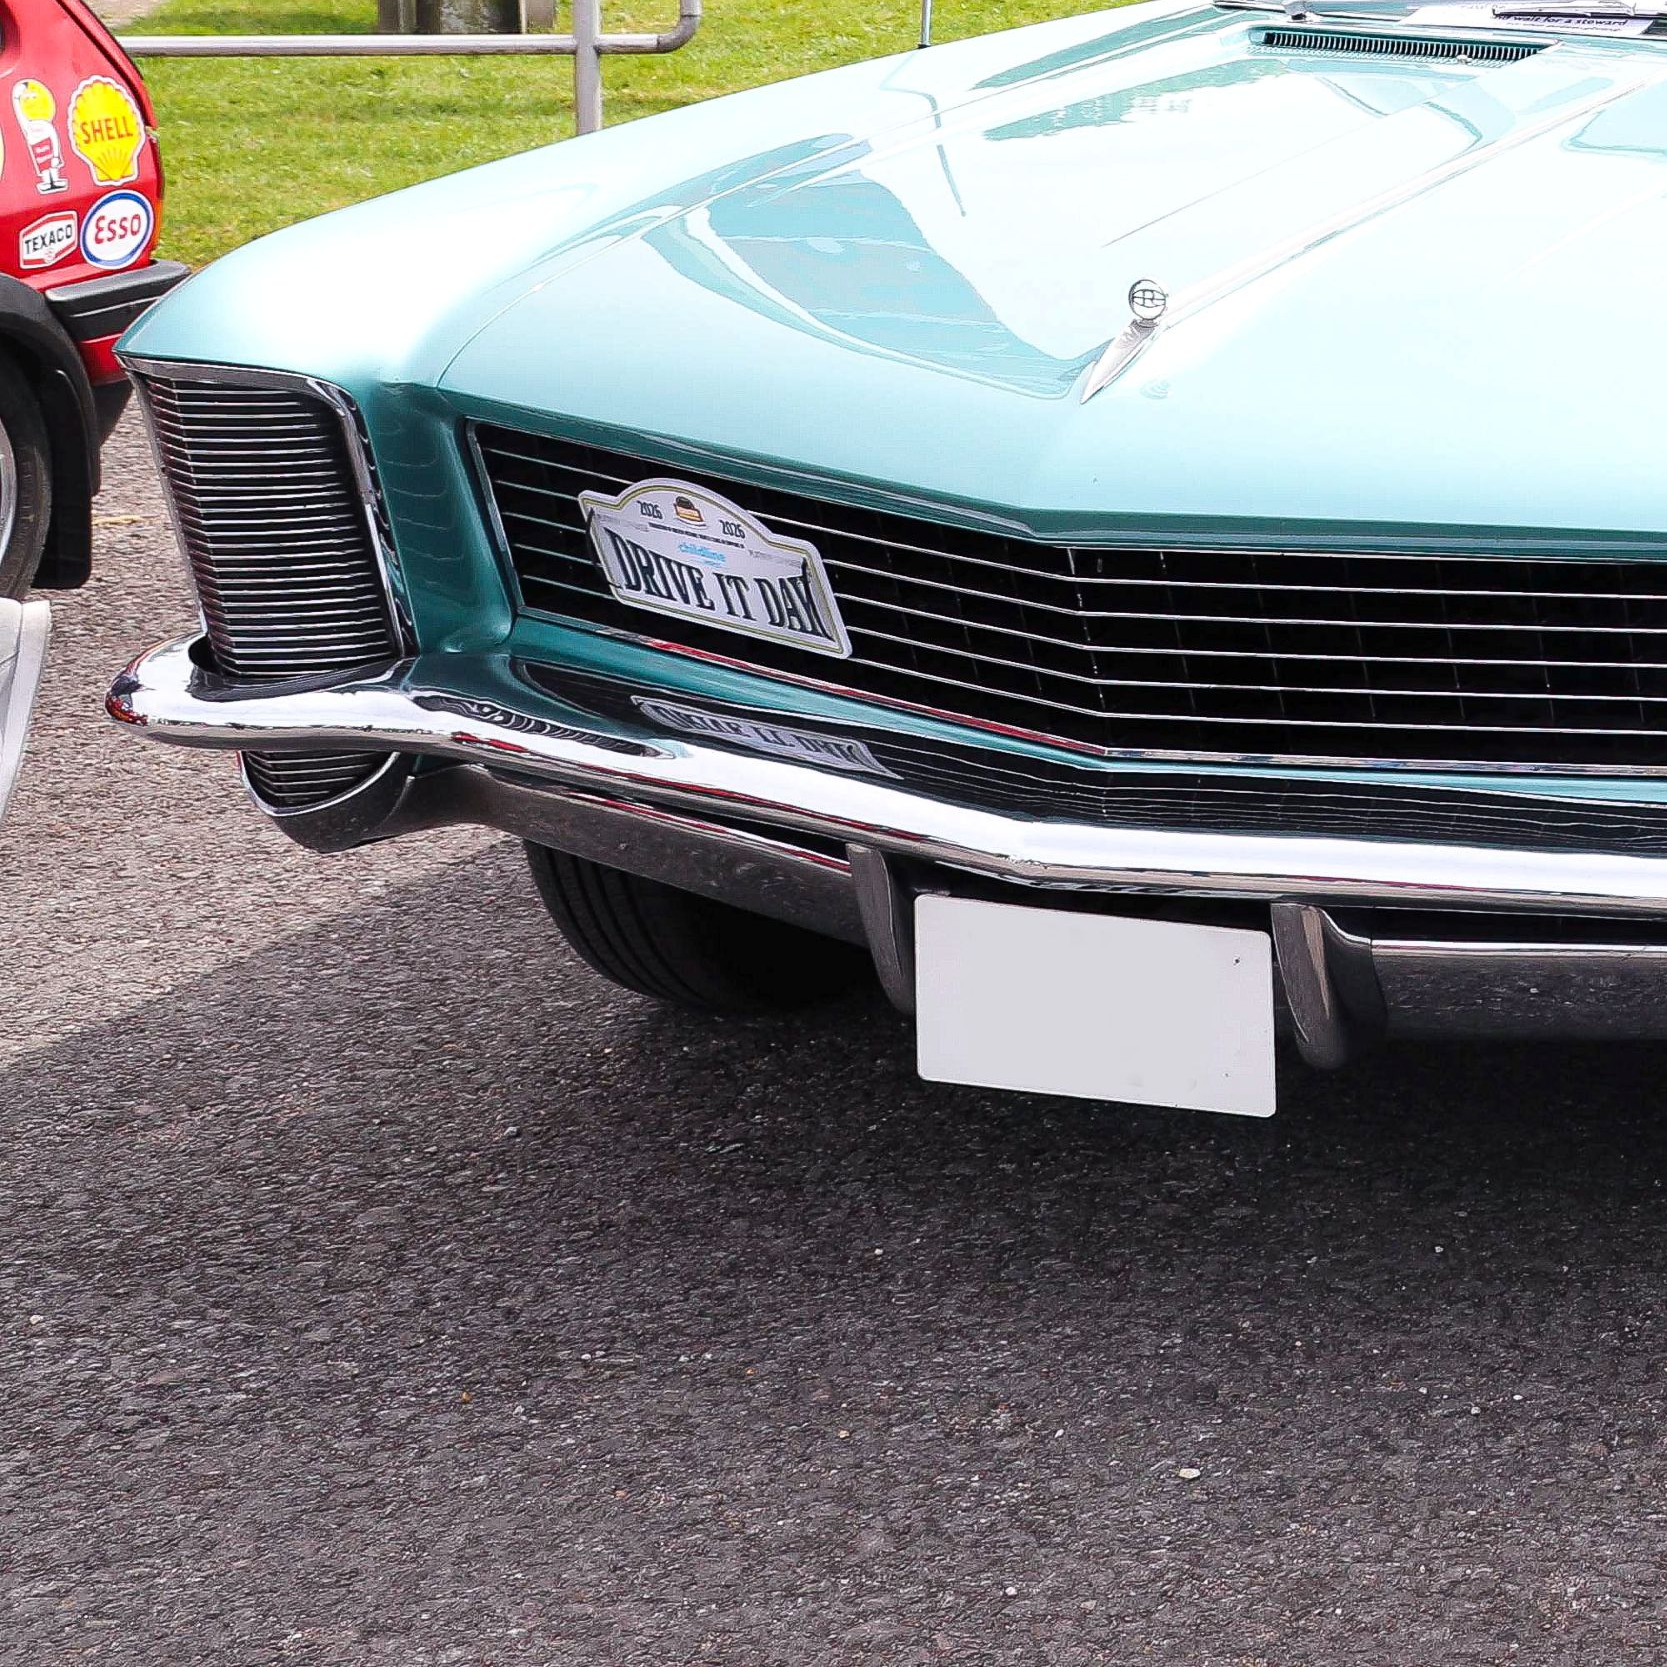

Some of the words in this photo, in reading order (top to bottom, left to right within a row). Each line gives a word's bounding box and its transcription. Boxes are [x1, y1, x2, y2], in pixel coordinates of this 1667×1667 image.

[80, 116, 134, 145] SHELL
[24, 224, 73, 255] TEXACO
[636, 500, 663, 520] 2026
[719, 519, 746, 539] 2026
[603, 526, 715, 611] DRIVE
[713, 572, 758, 621] IT
[753, 565, 836, 642] DAY
